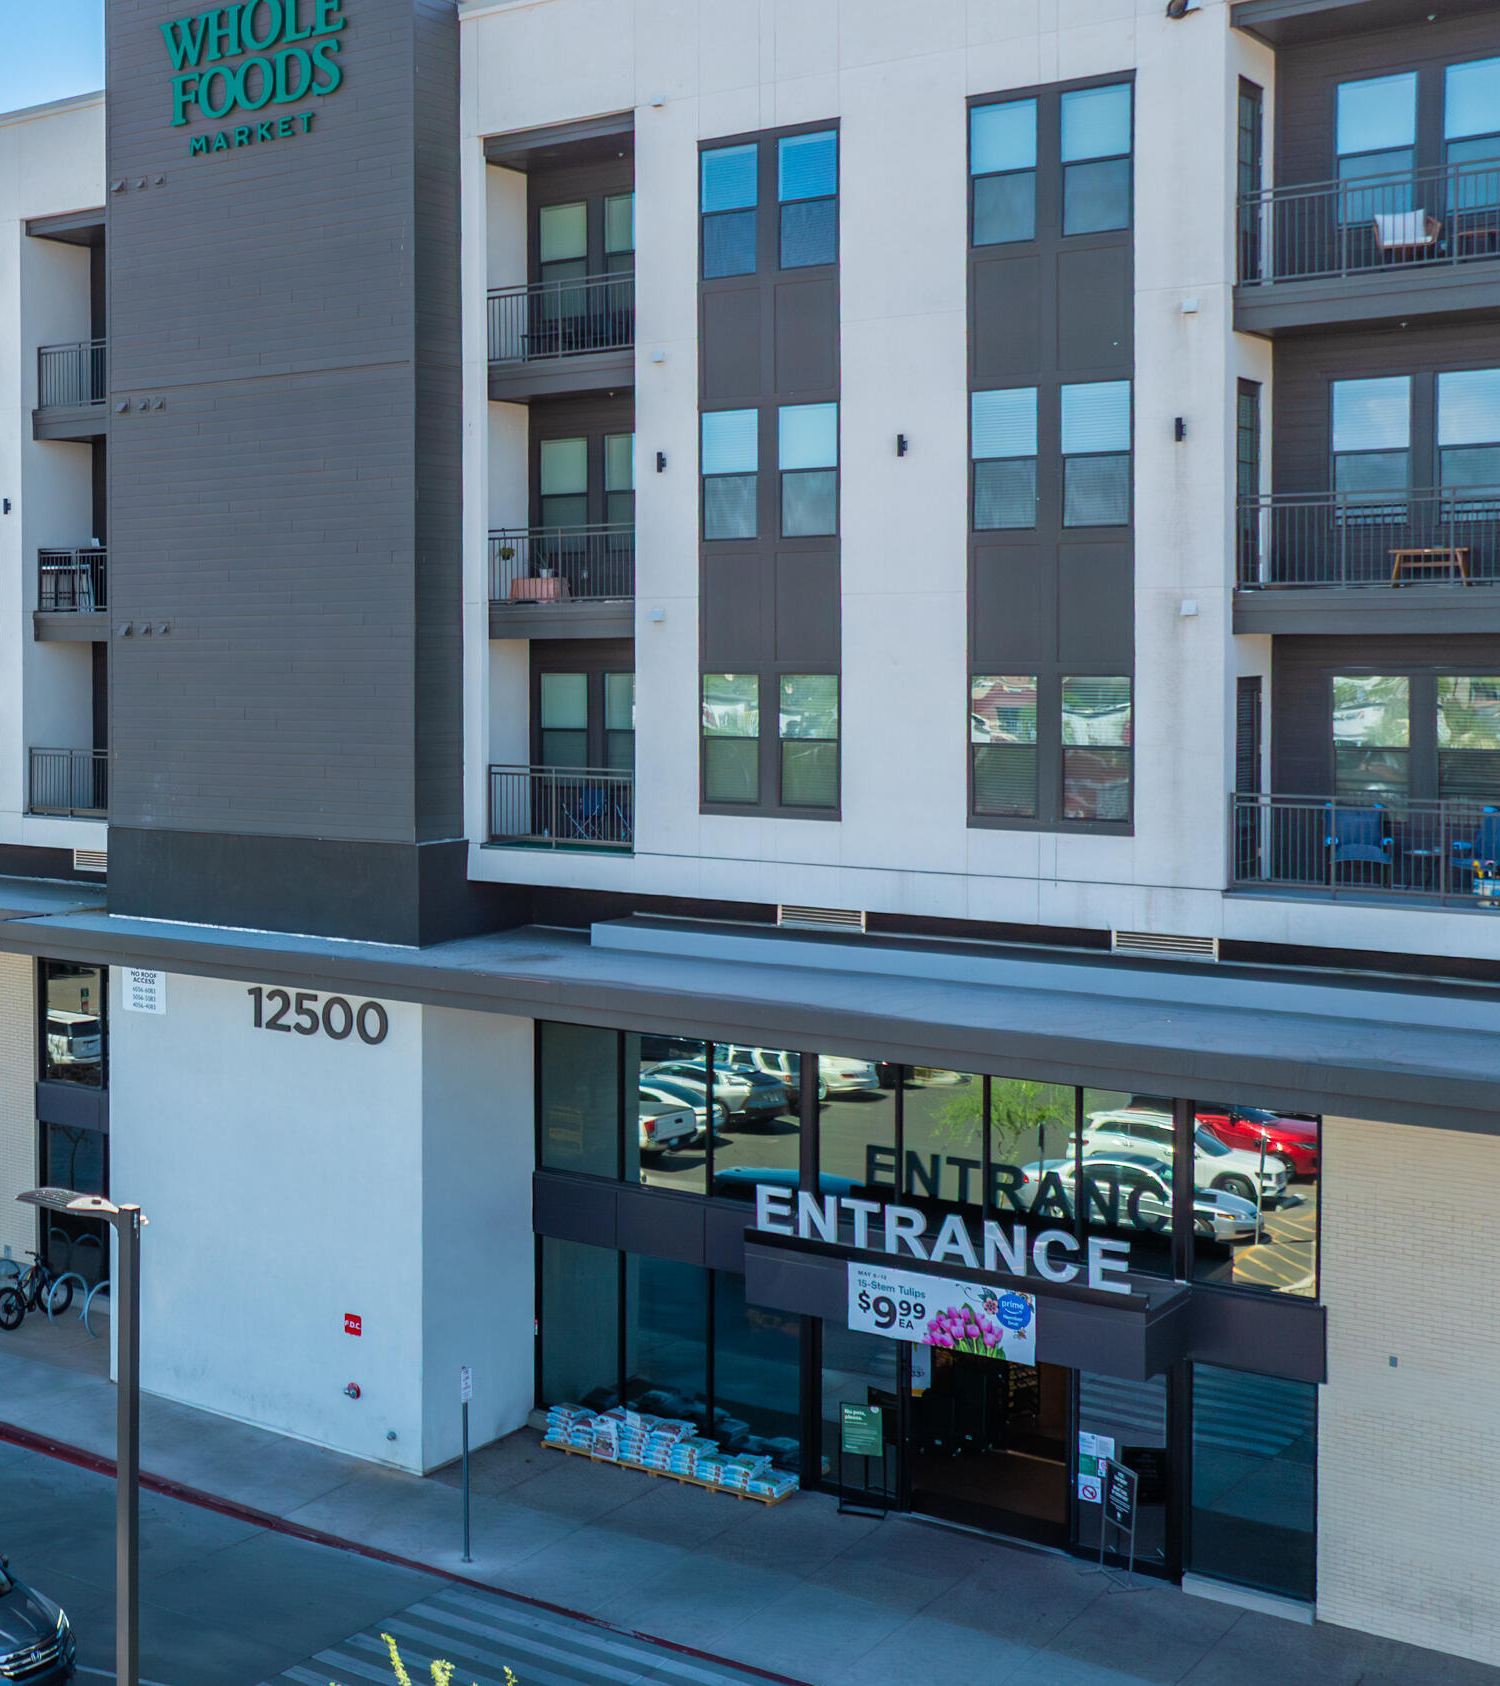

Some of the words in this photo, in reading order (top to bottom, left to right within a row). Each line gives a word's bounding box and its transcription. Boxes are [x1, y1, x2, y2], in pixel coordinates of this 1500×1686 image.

[158, 0, 347, 72] WHOLE
[170, 38, 343, 127] FOODS
[189, 112, 315, 157] MARKET
[133, 977, 156, 985] ACCESS
[247, 986, 389, 1045] 12500
[756, 1184, 1132, 1296] ENTRANCE
[858, 1279, 895, 1293] 15-Stem
[899, 1285, 926, 1299] Tulips
[1002, 1300, 1025, 1310] prime
[899, 1318, 914, 1330] EA
